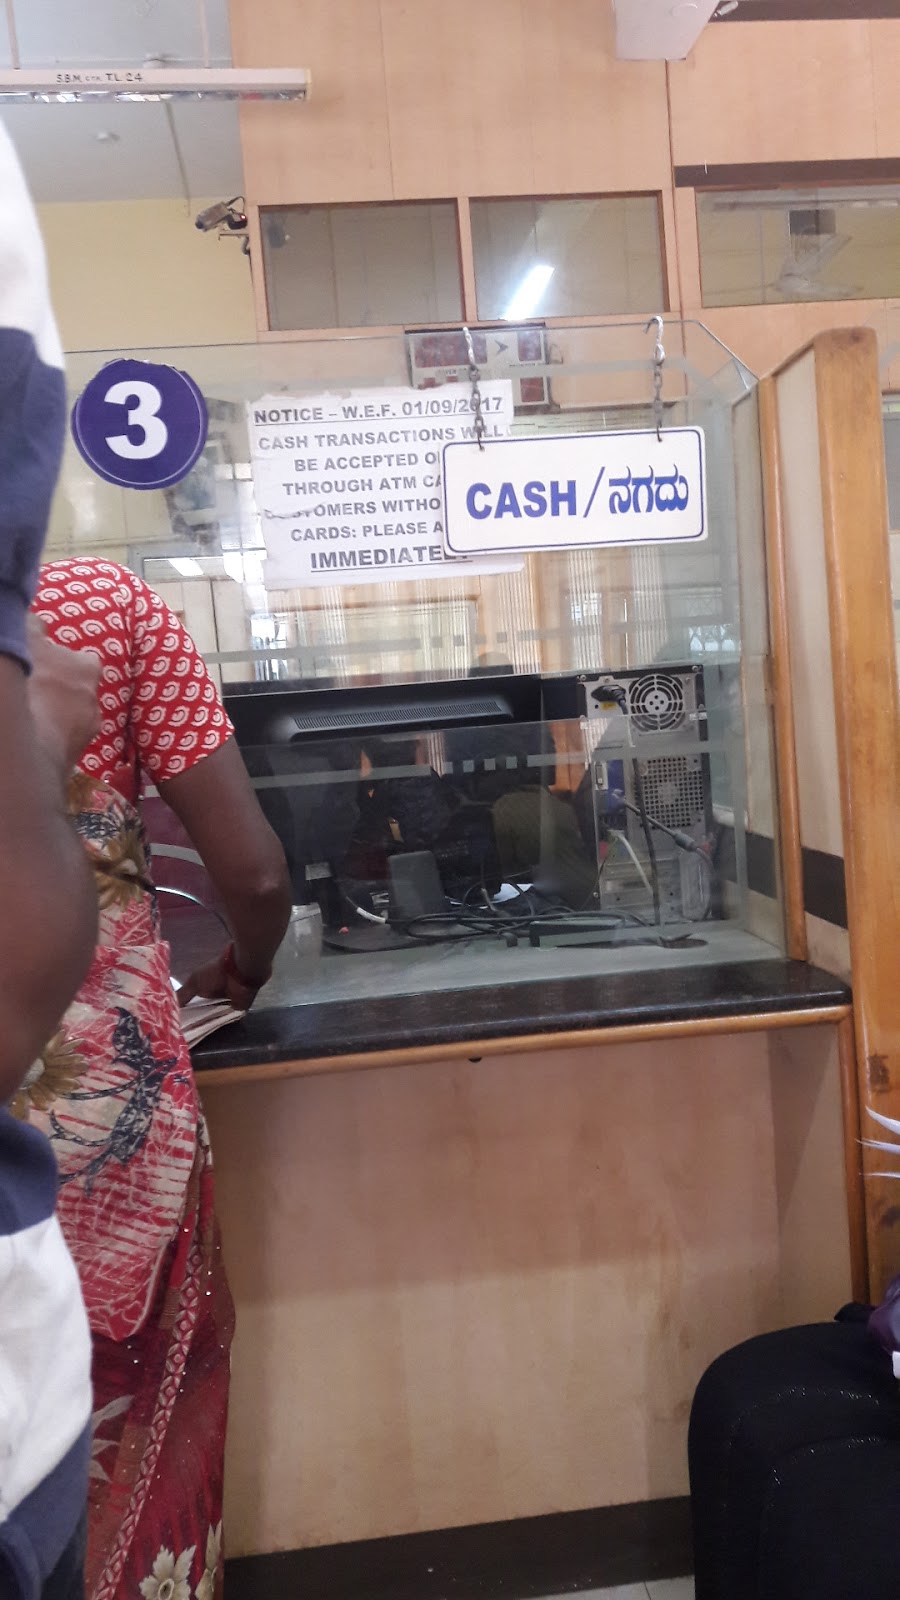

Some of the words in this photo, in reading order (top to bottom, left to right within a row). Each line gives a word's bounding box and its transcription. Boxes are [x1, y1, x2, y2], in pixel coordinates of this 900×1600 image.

[104, 380, 168, 460] 3
[254, 407, 324, 424] NOTICE
[342, 403, 396, 420] W.E.F.
[258, 435, 309, 451] CASH
[314, 427, 456, 447] TRANSACTIONS
[461, 424, 504, 440] WLL
[294, 458, 319, 472] BE
[324, 452, 420, 471] ACCEPTED
[424, 450, 440, 465] O
[282, 478, 374, 496] THROUGH
[379, 475, 418, 491] ATM
[465, 479, 578, 520] CASH
[608, 464, 690, 514] ನಗದು
[290, 525, 358, 543] CARDS:
[362, 520, 428, 538] PLEASE
